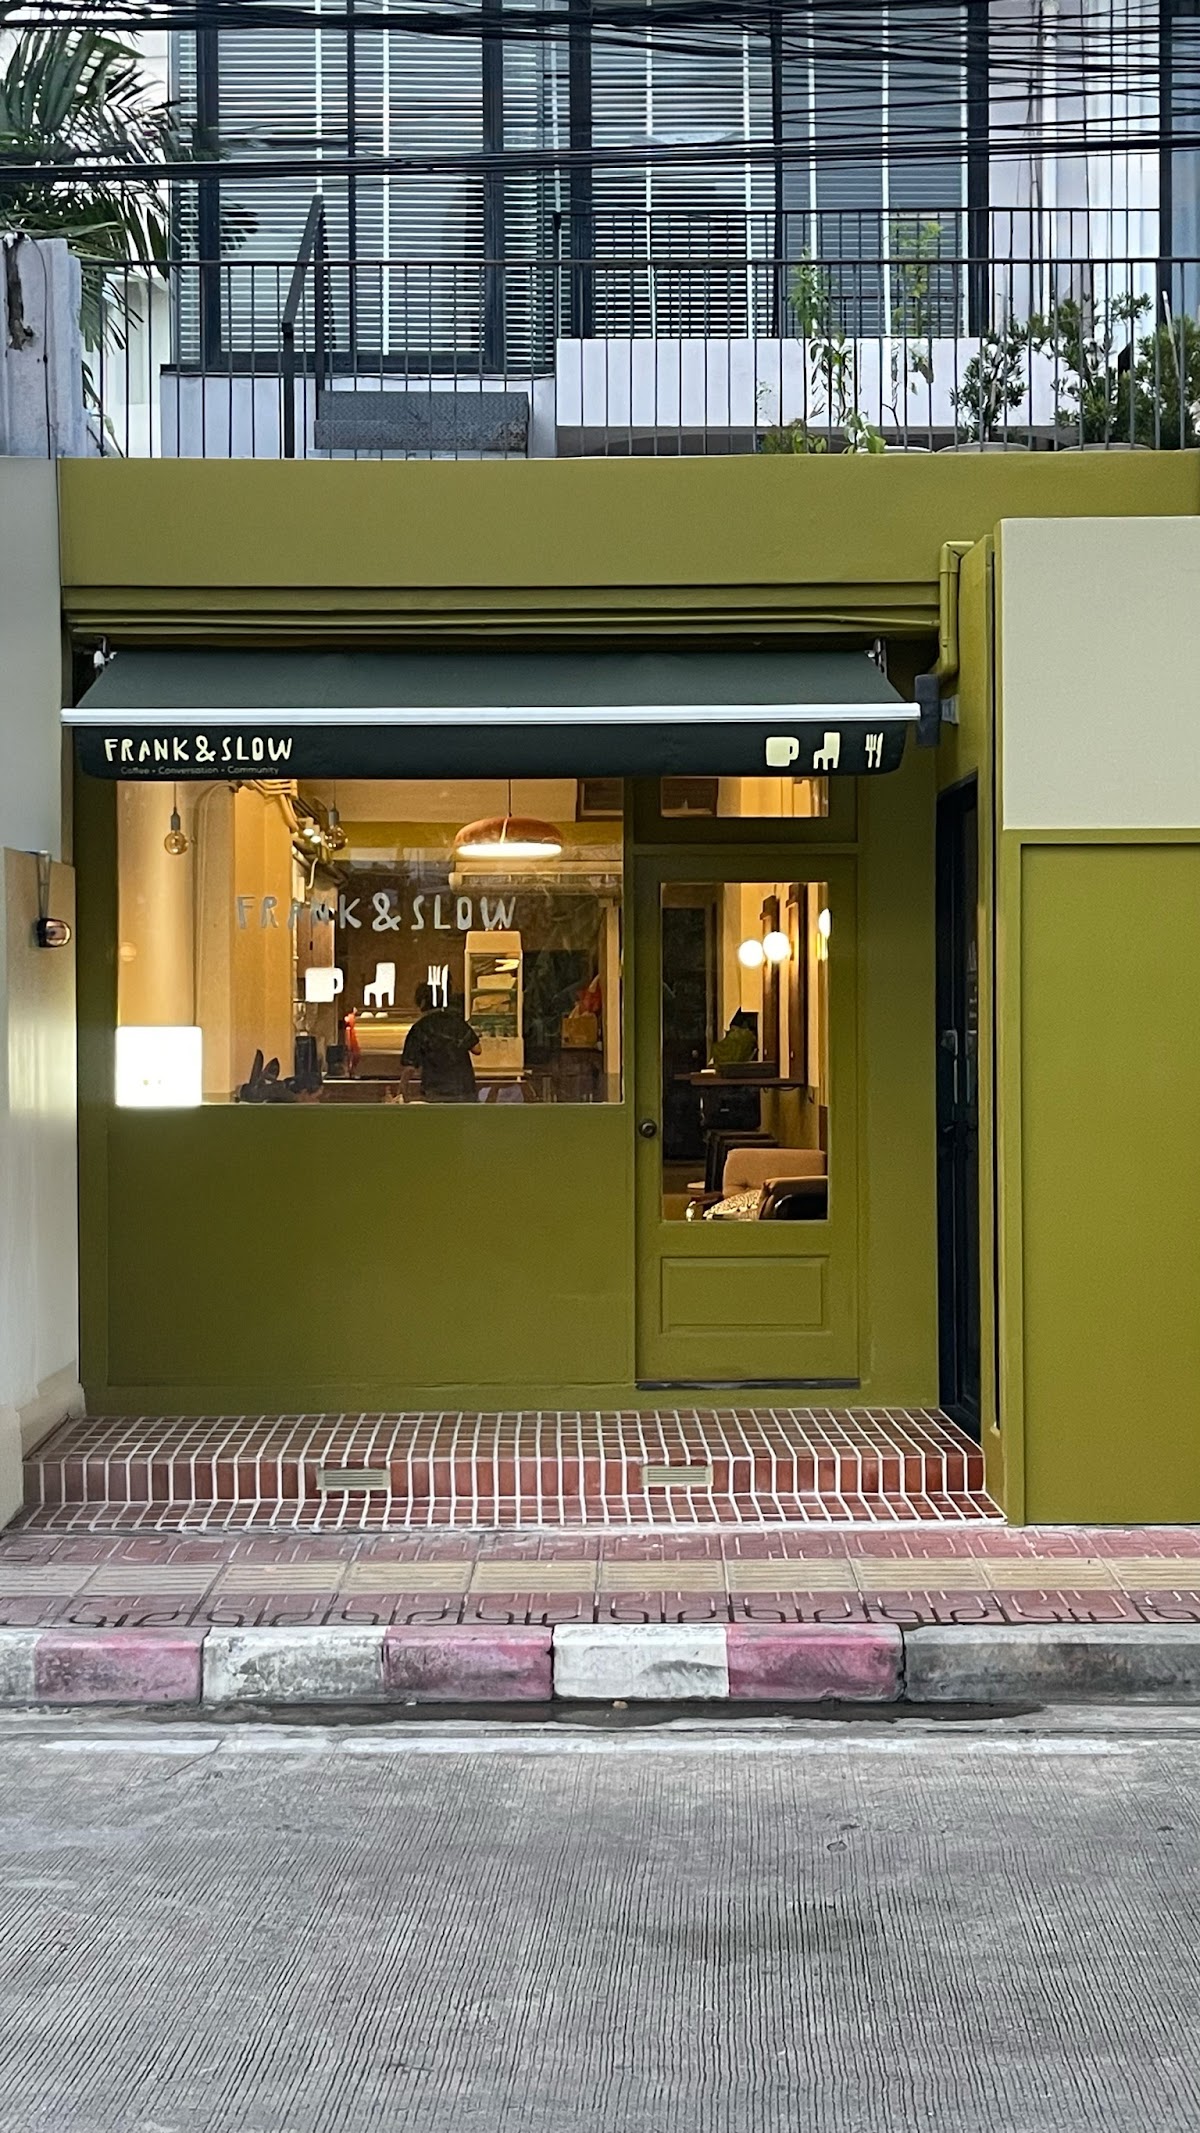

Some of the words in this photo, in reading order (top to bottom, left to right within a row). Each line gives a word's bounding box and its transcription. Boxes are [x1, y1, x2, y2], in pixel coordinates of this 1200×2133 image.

[120, 766, 149, 775] Coffee
[158, 766, 218, 775] Conversation
[227, 765, 279, 775] Community
